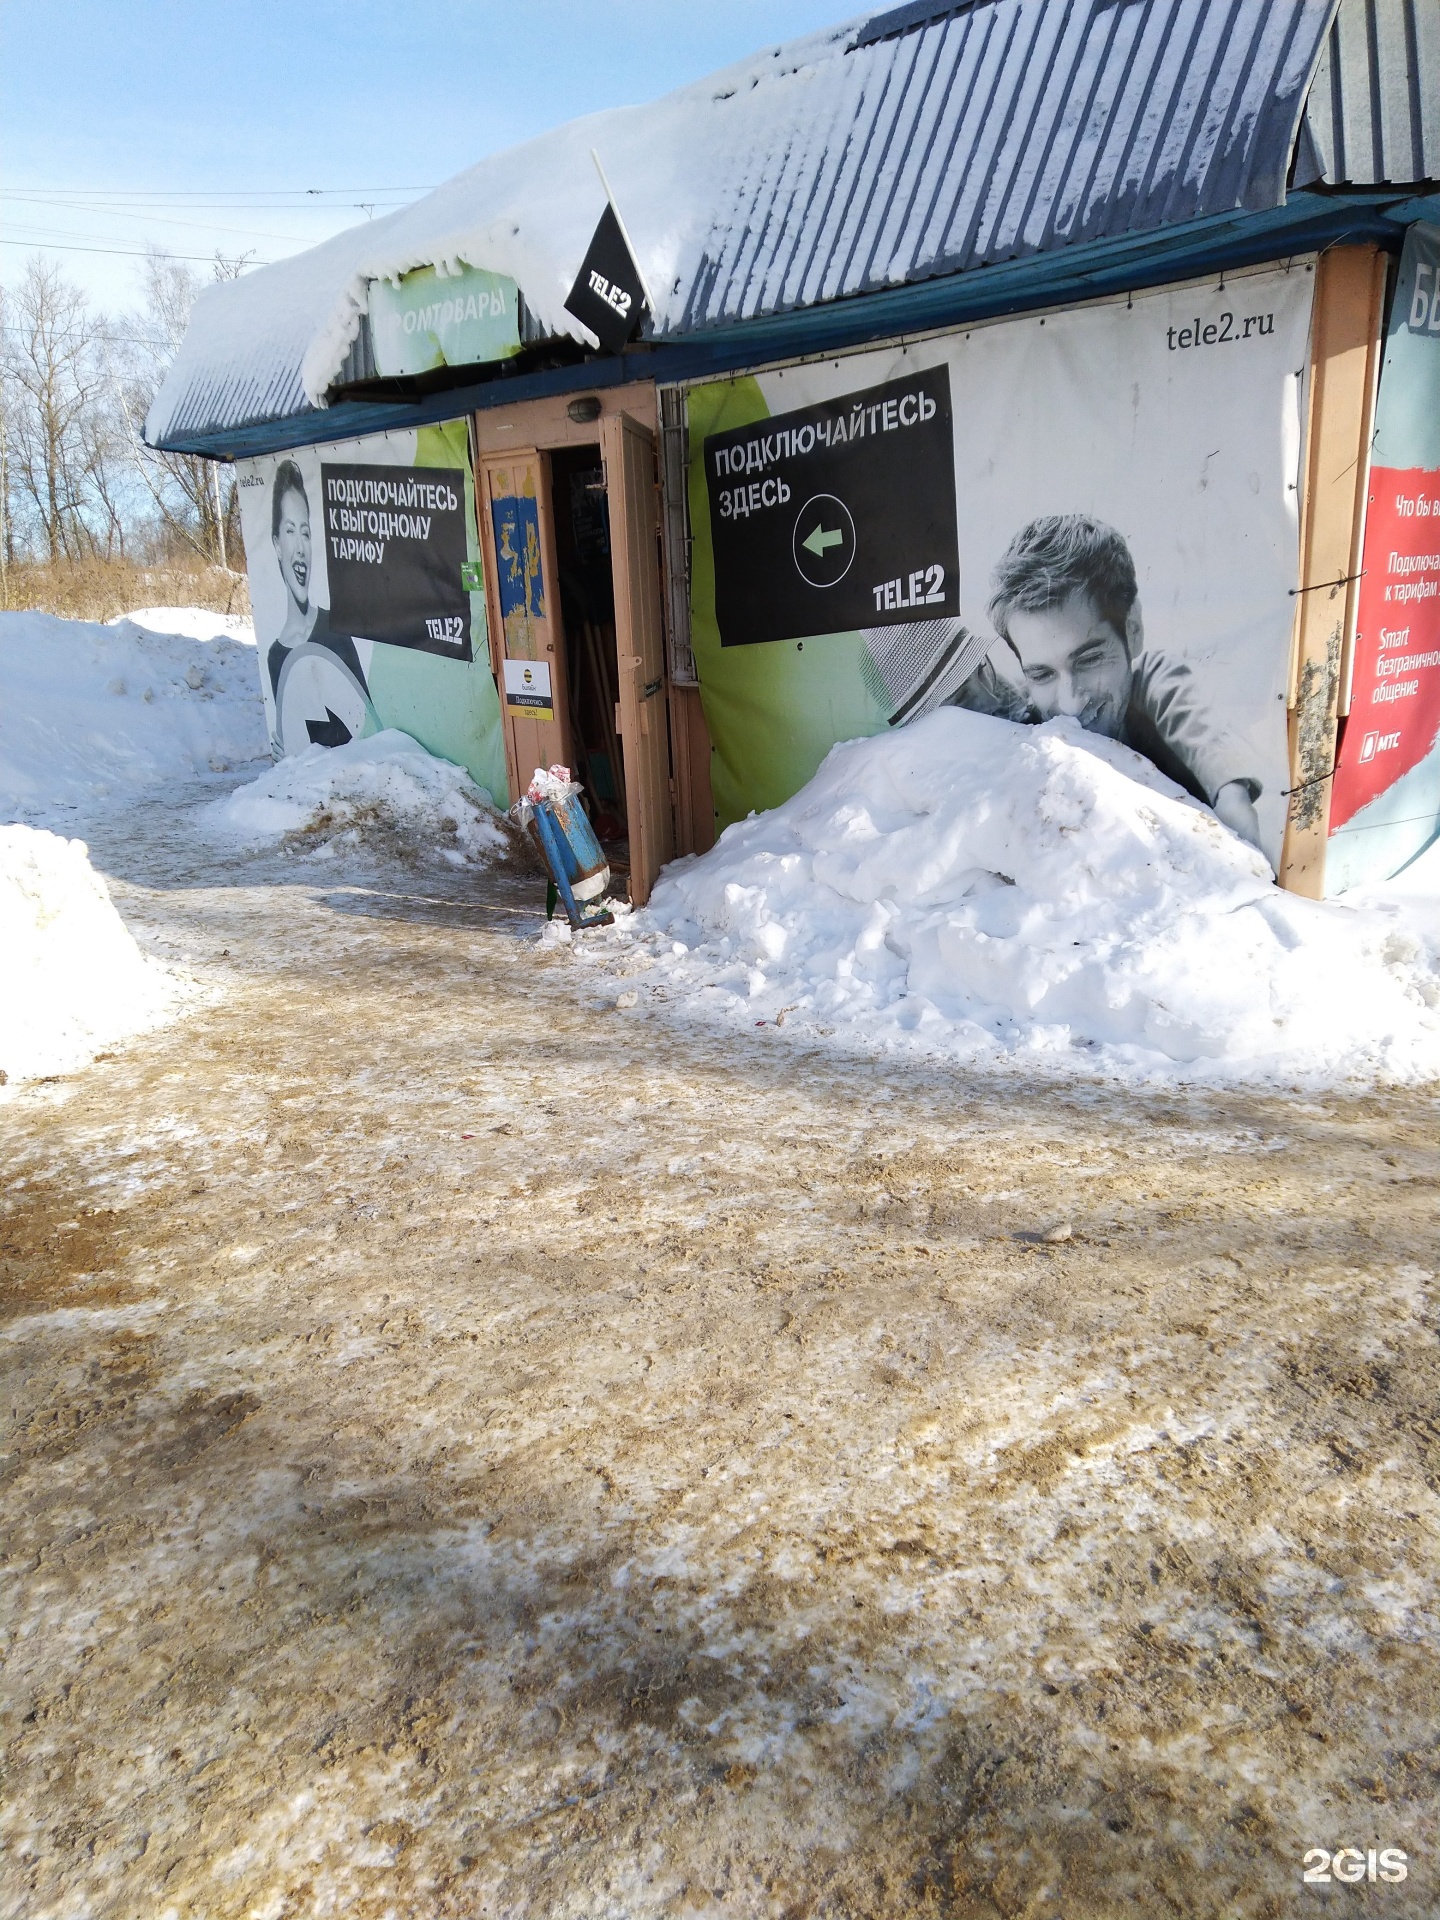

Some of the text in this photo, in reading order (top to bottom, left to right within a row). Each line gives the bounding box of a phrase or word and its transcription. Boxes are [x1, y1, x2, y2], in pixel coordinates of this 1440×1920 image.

[588, 269, 632, 319] TELE2
[1166, 312, 1275, 351] tele2.ru
[714, 391, 937, 476] ПОДКЛЮЧАЙТЕСЬ
[240, 474, 265, 488] tele2.ru
[327, 477, 458, 511] ПОДКЛЮЧАЙТЕСЬ
[719, 477, 791, 520] ЗДЕСЬ
[1396, 493, 1440, 517] Что бы в
[329, 507, 431, 540] К ВЫГОДНОМУ
[331, 536, 385, 564] ТАРИФУ
[1388, 551, 1440, 576] Подключа
[873, 564, 946, 611] TELE2
[1385, 576, 1438, 605] к тарифам
[425, 616, 464, 645] TELE2
[1378, 625, 1410, 650] Smart
[1372, 679, 1419, 704] общение
[1377, 731, 1401, 753] МТС
